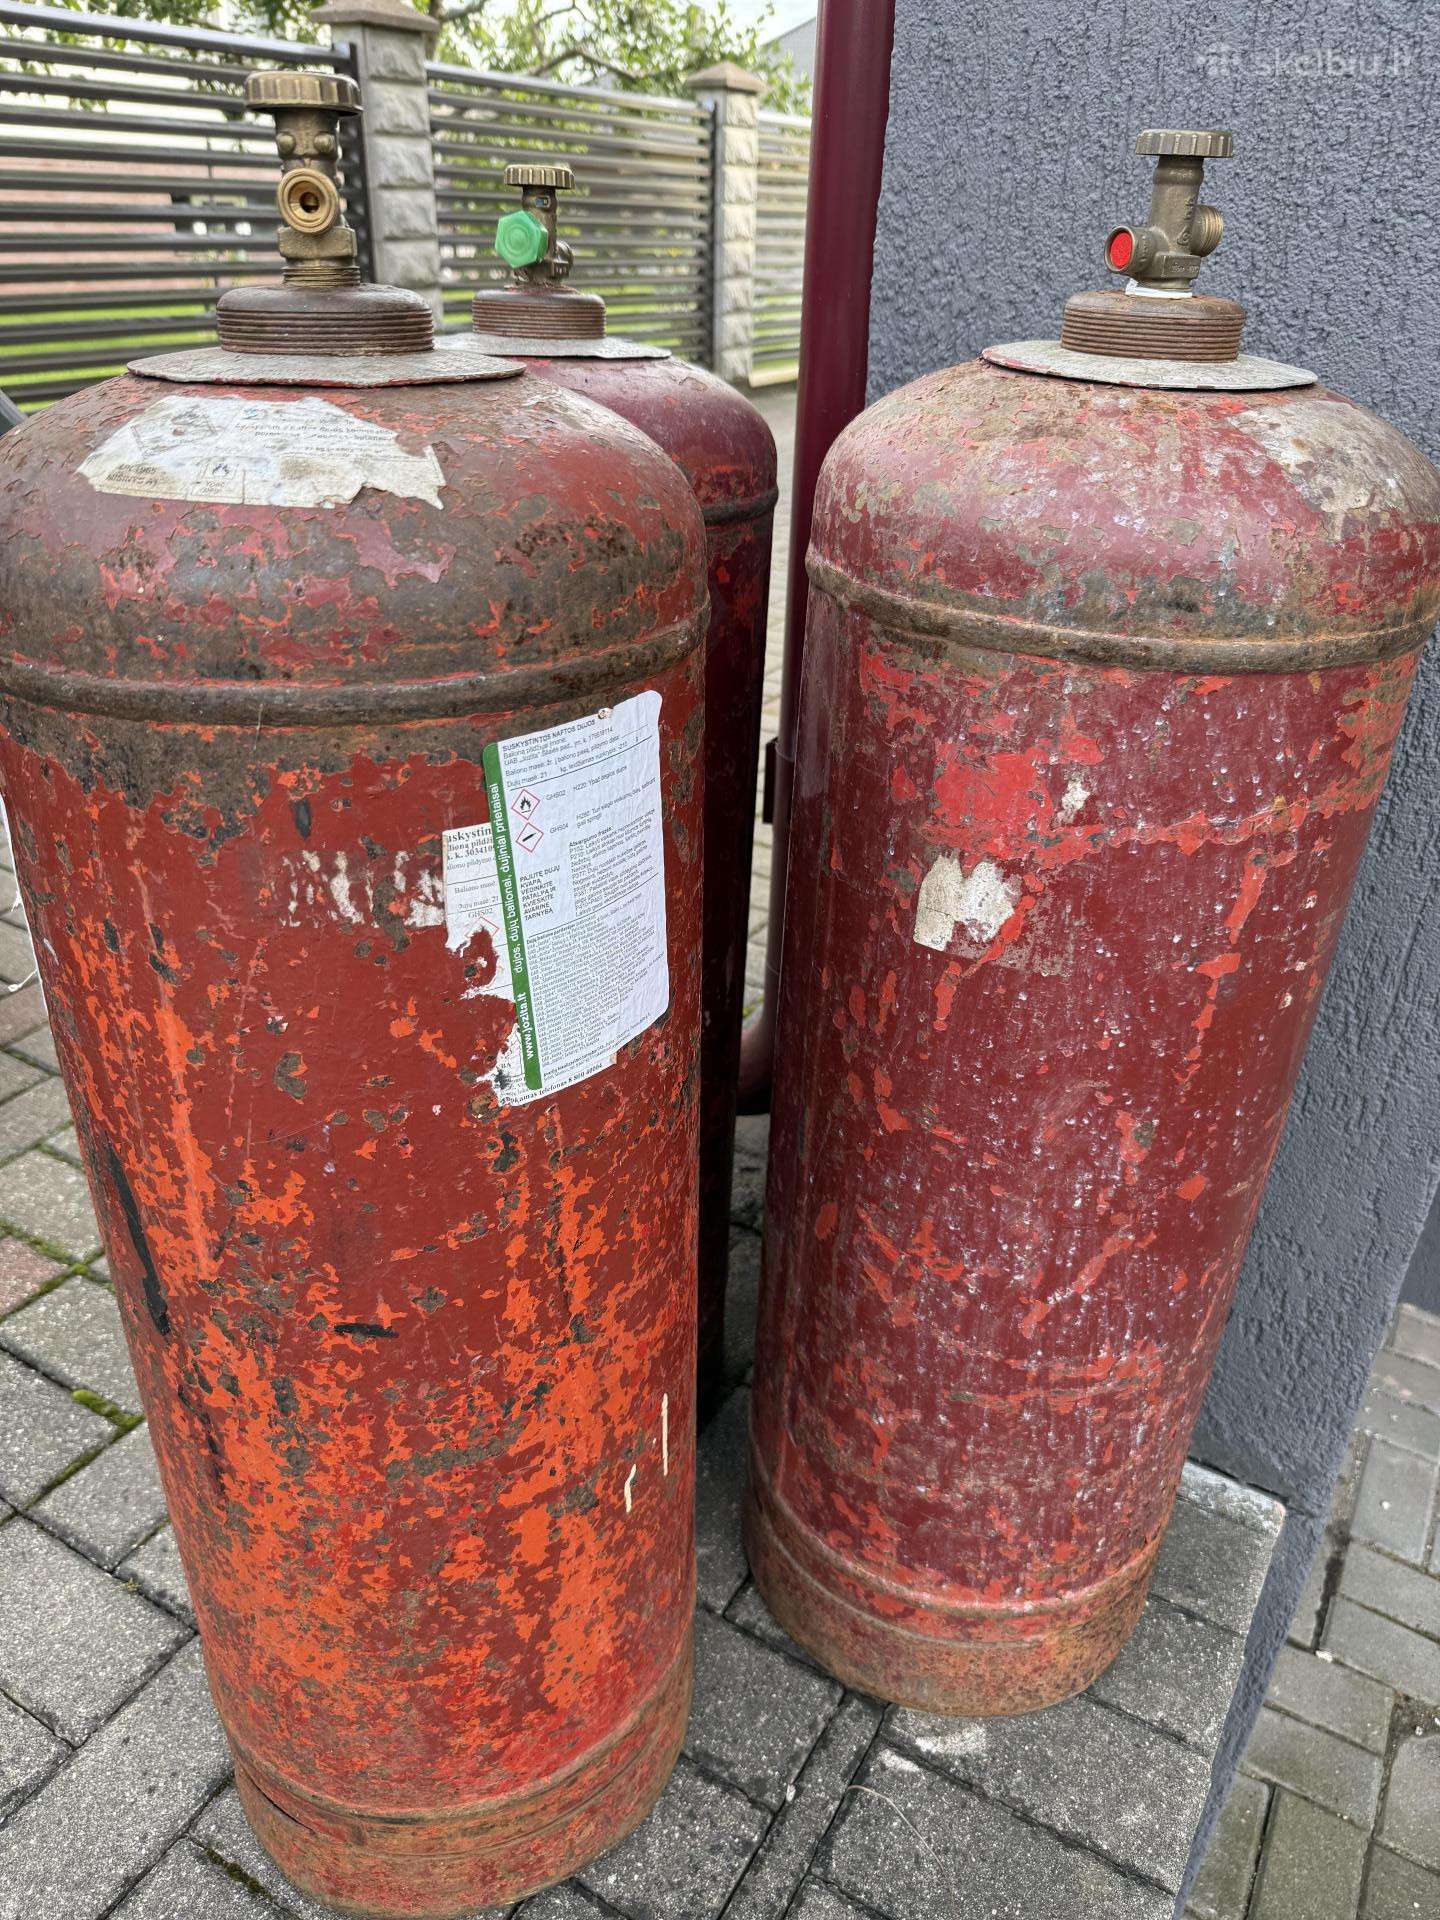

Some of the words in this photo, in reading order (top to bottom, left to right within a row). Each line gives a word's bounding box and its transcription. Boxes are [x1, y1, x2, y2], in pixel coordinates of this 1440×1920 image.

[502, 734, 552, 752] SUSKYSTINTOS
[552, 726, 576, 738] NAFTOS
[576, 719, 596, 730] DUJOS
[490, 784, 507, 832] prietaisai
[546, 790, 566, 801] GHS02
[497, 836, 510, 873] dujiniai
[502, 874, 516, 916] balionai,
[507, 917, 520, 942] dujų
[512, 944, 523, 974] dujos,
[517, 992, 534, 1060] www.jozita.lt
